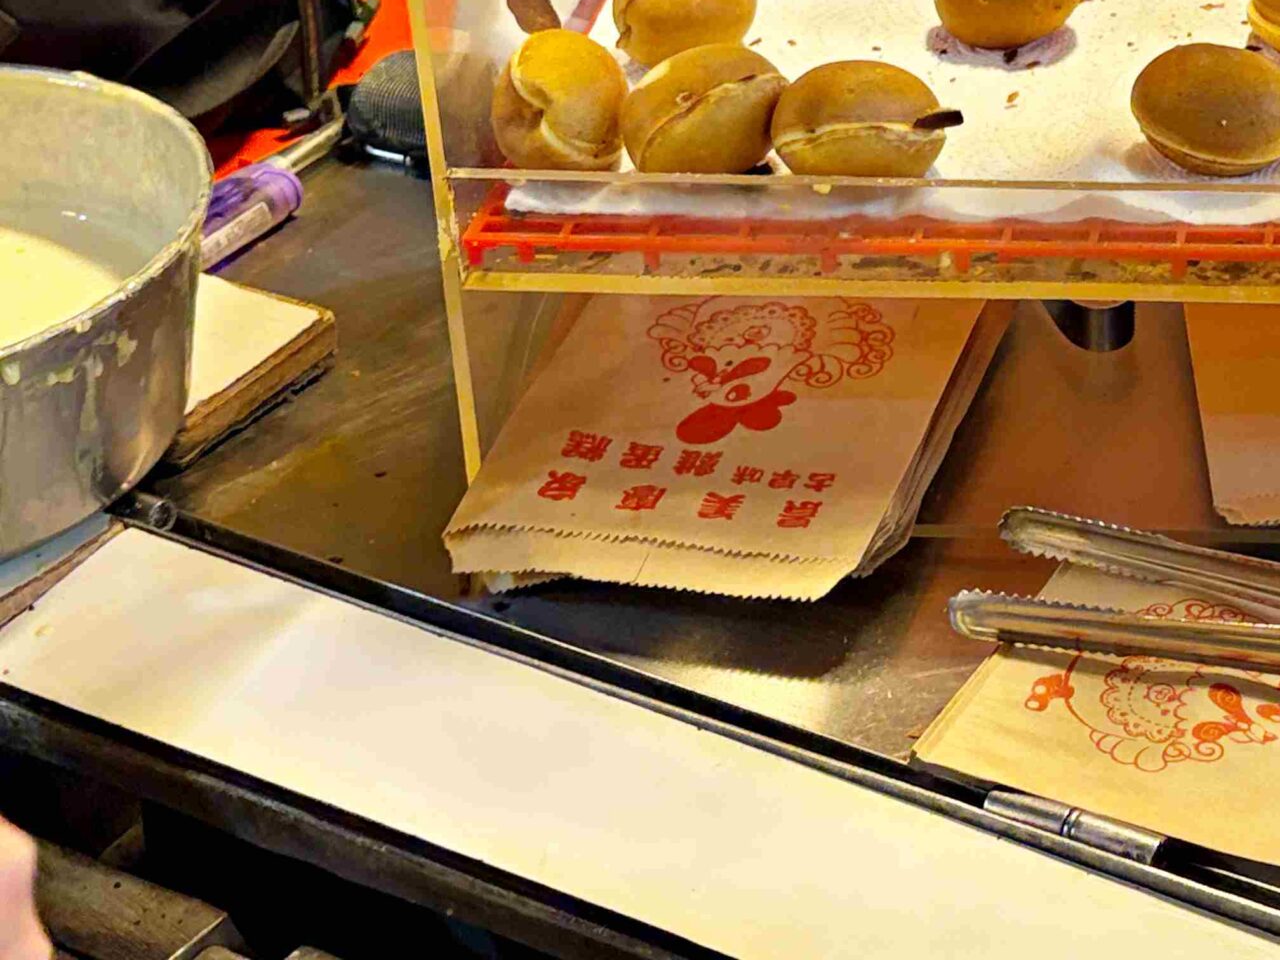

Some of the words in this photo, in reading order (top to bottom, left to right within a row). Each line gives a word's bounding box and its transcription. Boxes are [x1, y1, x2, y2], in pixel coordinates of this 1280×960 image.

[560, 430, 838, 492] 古早味雞蛋糕
[537, 469, 824, 529] 景美廖家
